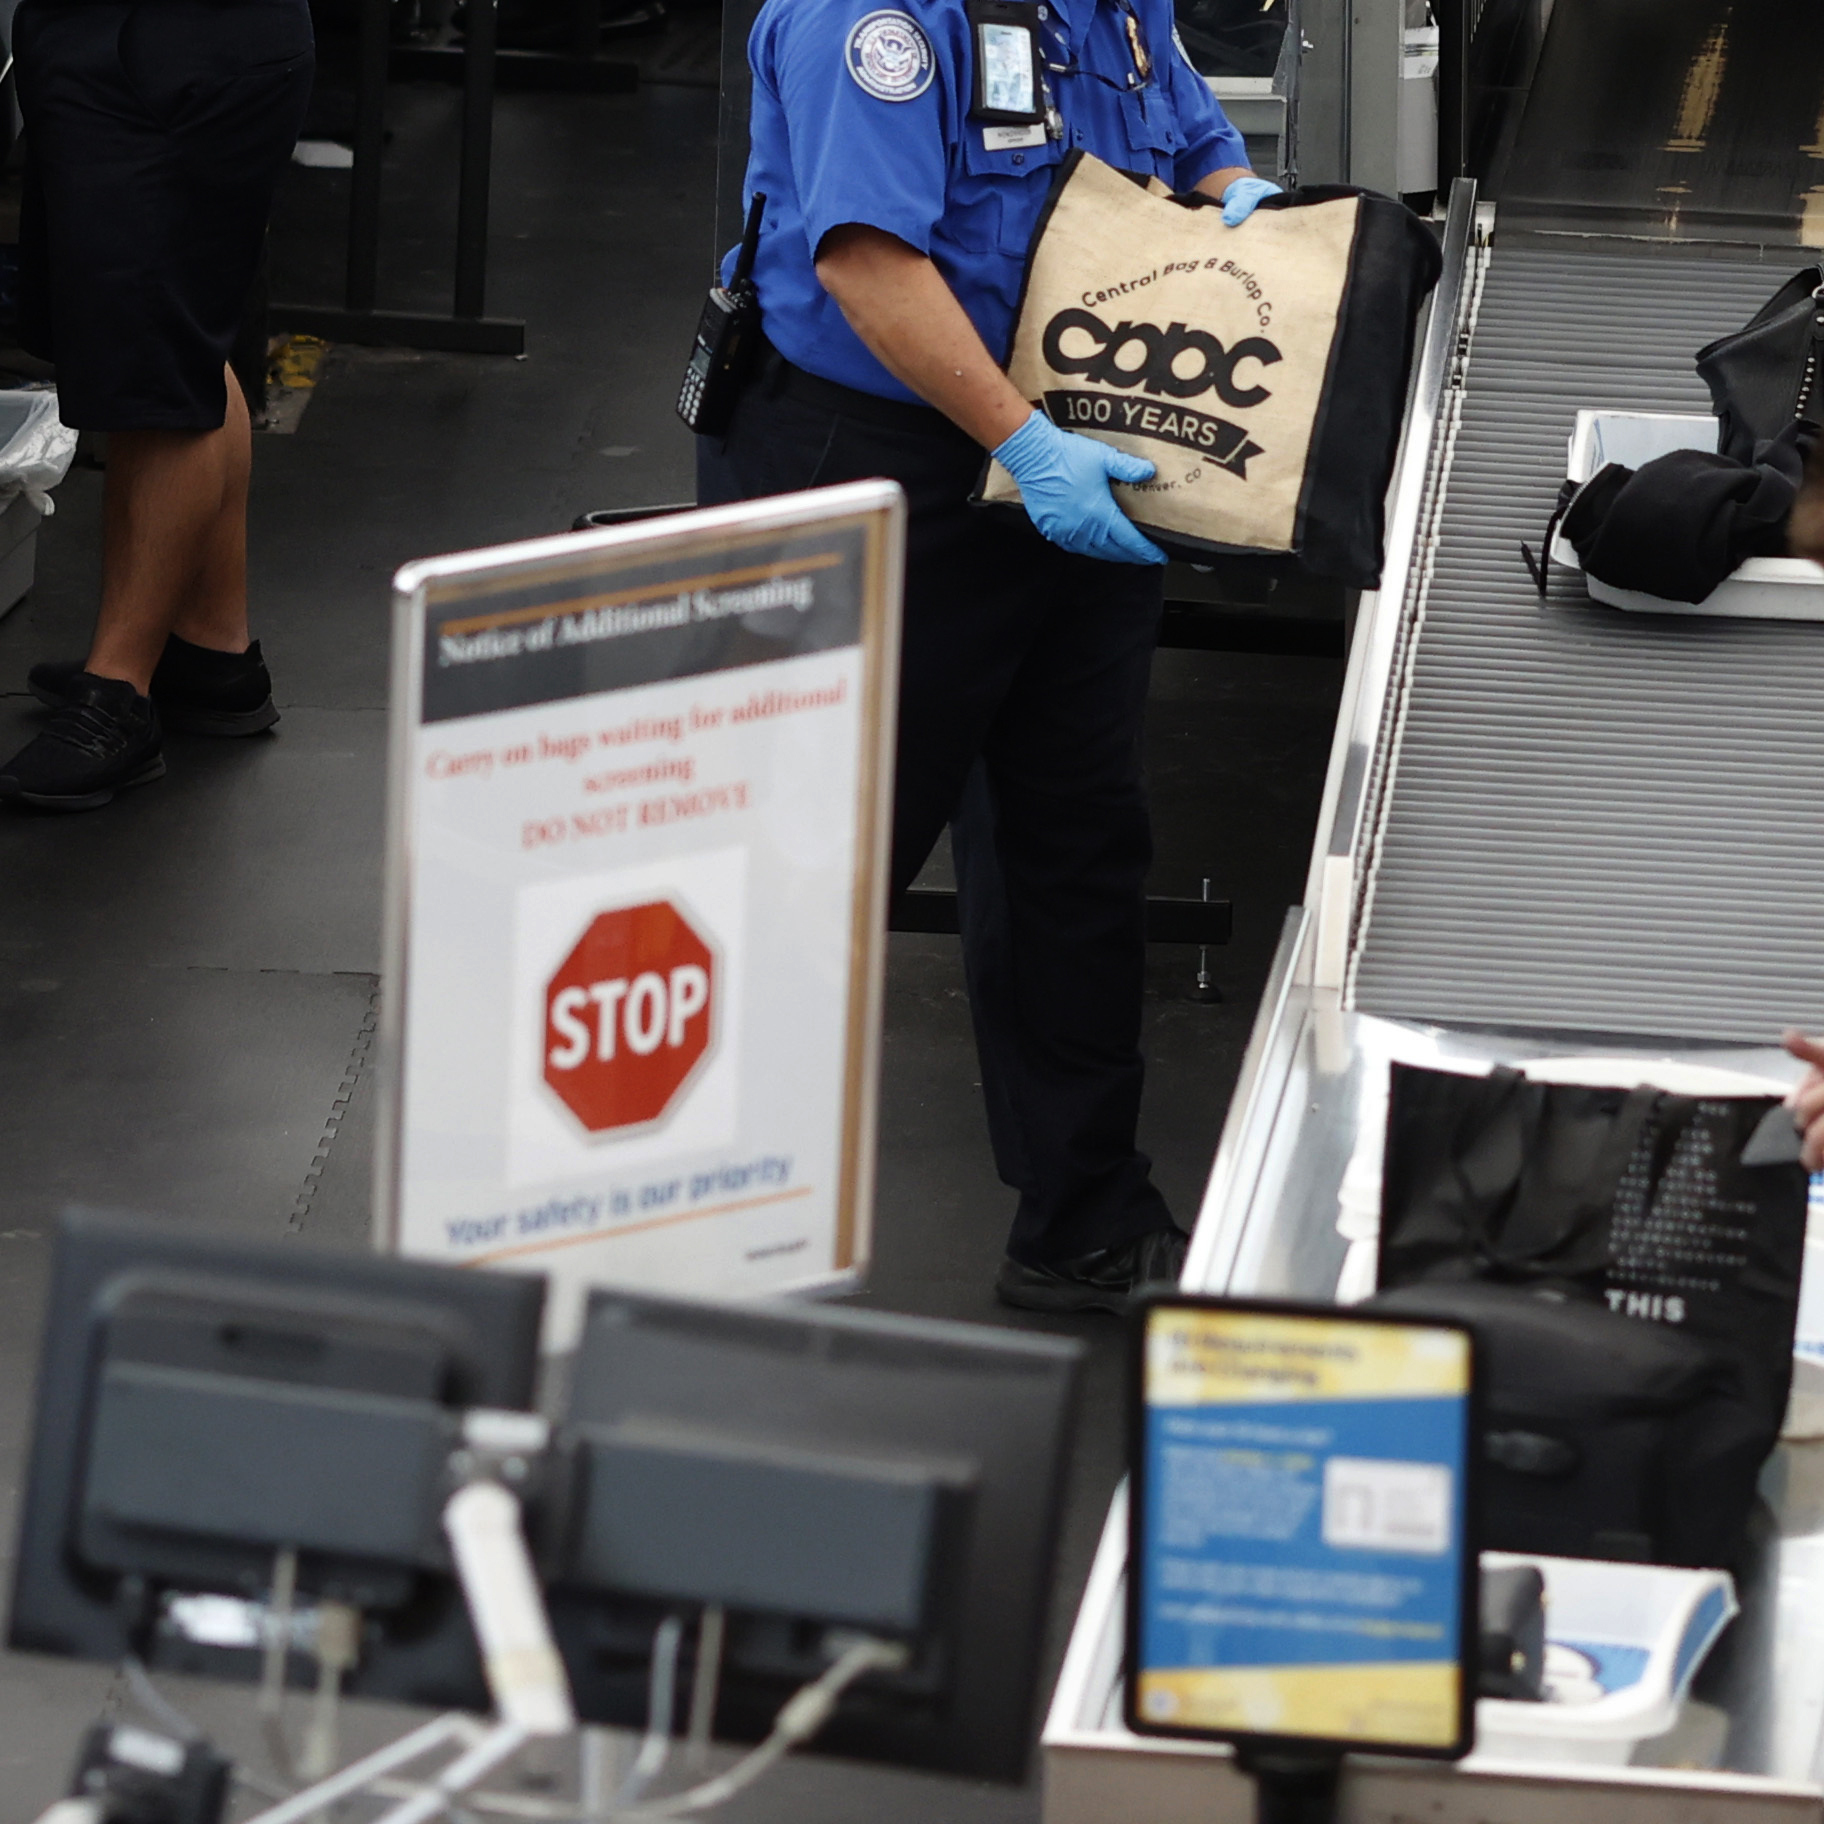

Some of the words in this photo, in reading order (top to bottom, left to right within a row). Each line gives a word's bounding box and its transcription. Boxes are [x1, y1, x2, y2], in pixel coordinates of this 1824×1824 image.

[1081, 269, 1159, 308] Central
[1162, 259, 1200, 277] Bag
[1203, 257, 1219, 270] &
[1218, 259, 1263, 301] Burlap
[1256, 301, 1273, 334] Co.
[1066, 396, 1112, 423] 100
[1122, 401, 1219, 447] YEARS
[1184, 467, 1203, 484] CO
[438, 626, 522, 668] Notice
[524, 619, 556, 652] of
[557, 591, 691, 646] Additional
[693, 575, 815, 620] Screening
[426, 748, 496, 782] Carry
[501, 743, 531, 767] on
[538, 732, 592, 764] bags
[598, 713, 684, 749] waiting
[689, 703, 724, 731] for
[730, 677, 848, 726] additional
[582, 756, 697, 796] screening
[521, 819, 567, 849] DO
[575, 806, 628, 840] NOT
[637, 780, 752, 830] REMOVE
[549, 963, 709, 1071] STOP
[444, 1213, 508, 1247] Your
[517, 1193, 601, 1234] safety
[609, 1189, 631, 1216] is
[638, 1180, 681, 1211] our
[688, 1154, 793, 1202] priority
[1604, 1288, 1686, 1323] THIS
